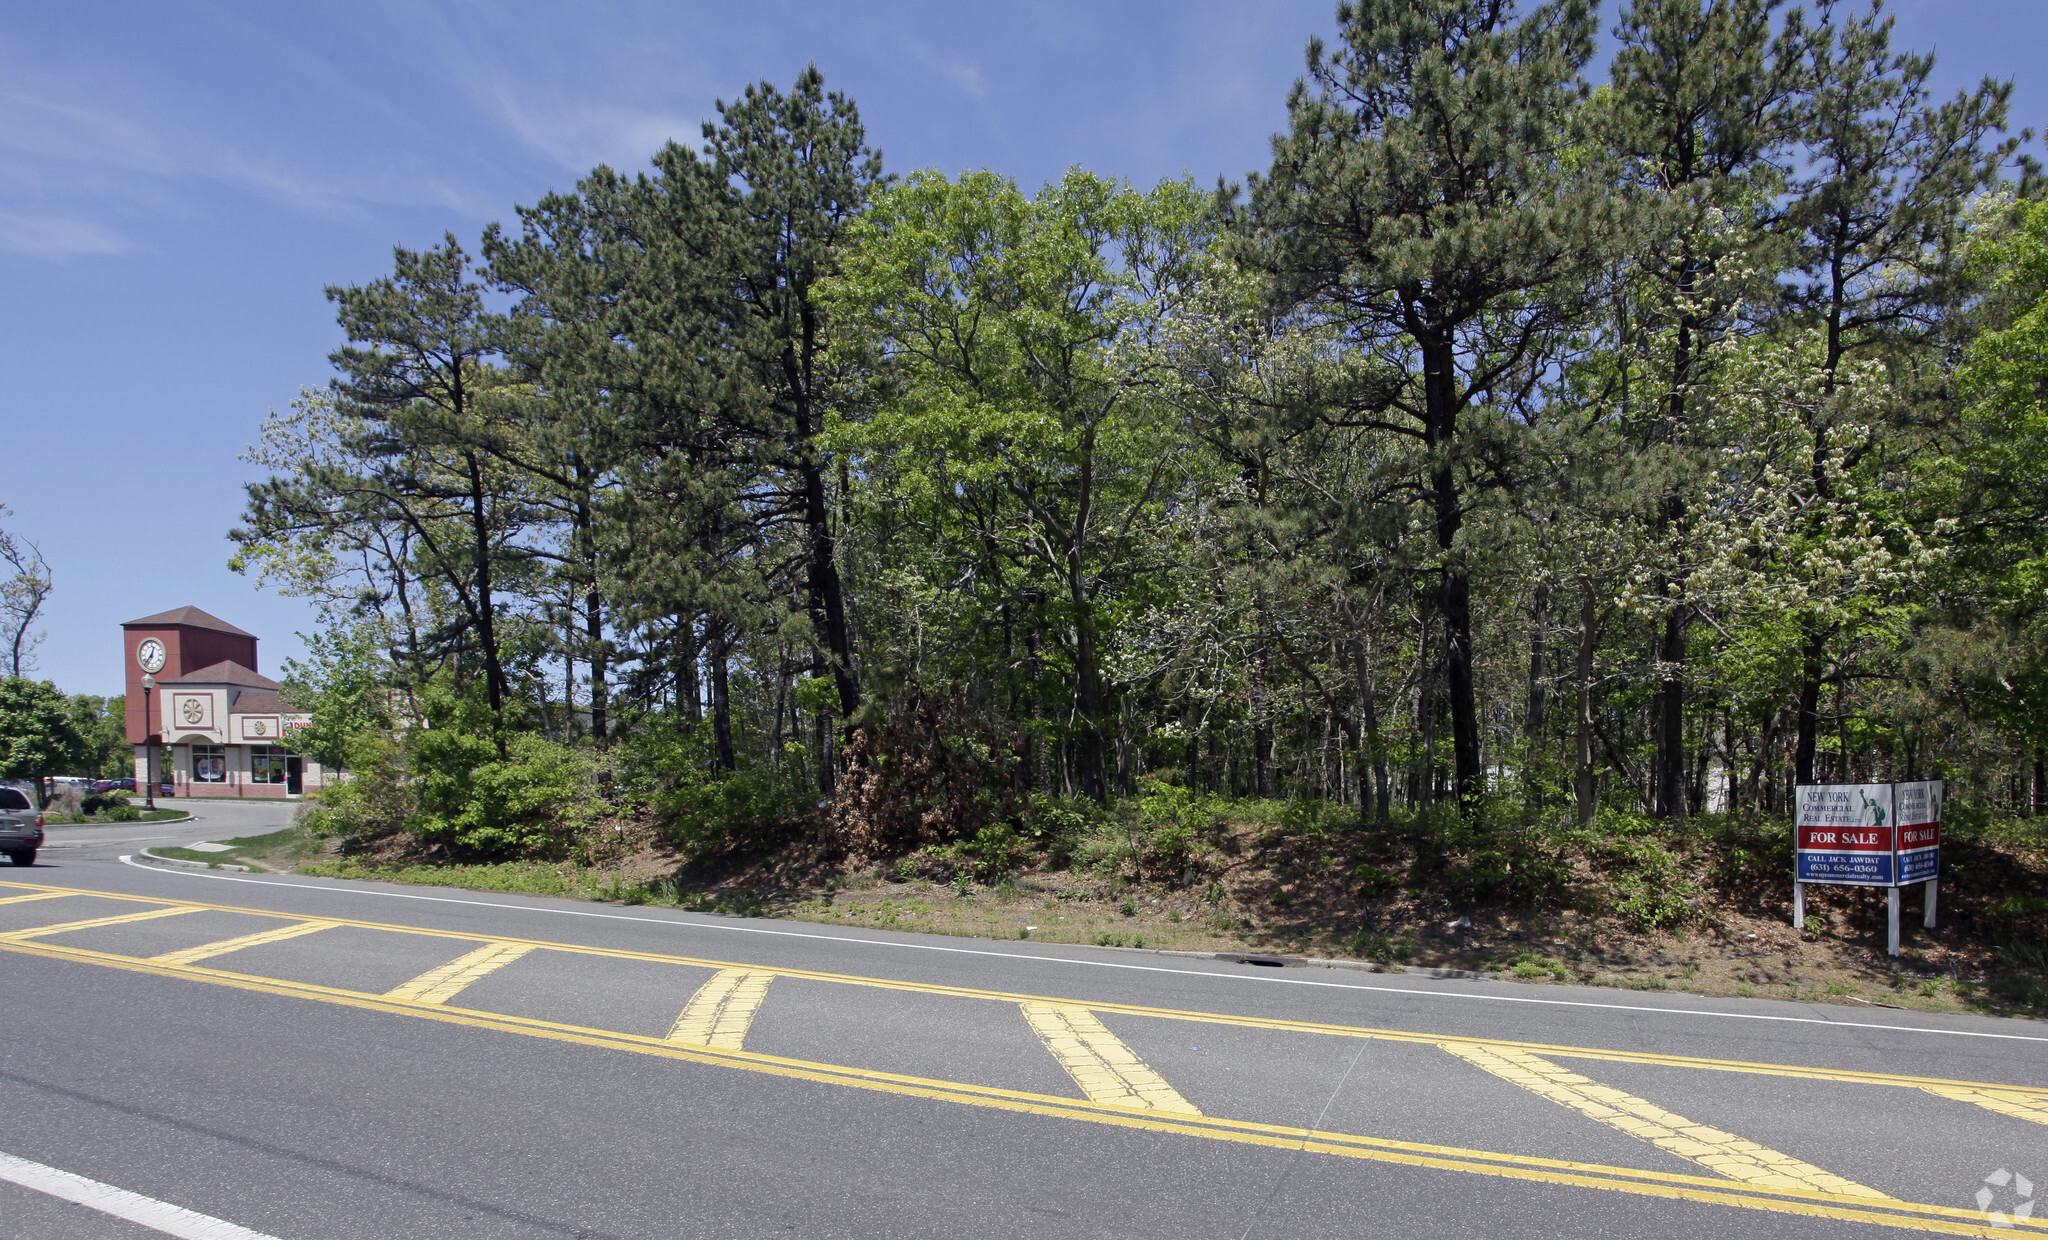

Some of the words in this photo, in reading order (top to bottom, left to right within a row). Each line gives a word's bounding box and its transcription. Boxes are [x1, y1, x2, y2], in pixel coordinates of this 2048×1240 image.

[1807, 791, 1825, 803] NEW
[1828, 791, 1850, 803] YORK
[1803, 813, 1822, 822] REAL
[1809, 831, 1837, 844] FOR
[1841, 832, 1879, 845] SALE
[1903, 830, 1918, 844] FOR
[1919, 828, 1935, 841] SALE
[1810, 863, 1830, 872] (631)
[1833, 864, 1878, 873] 656-0360
